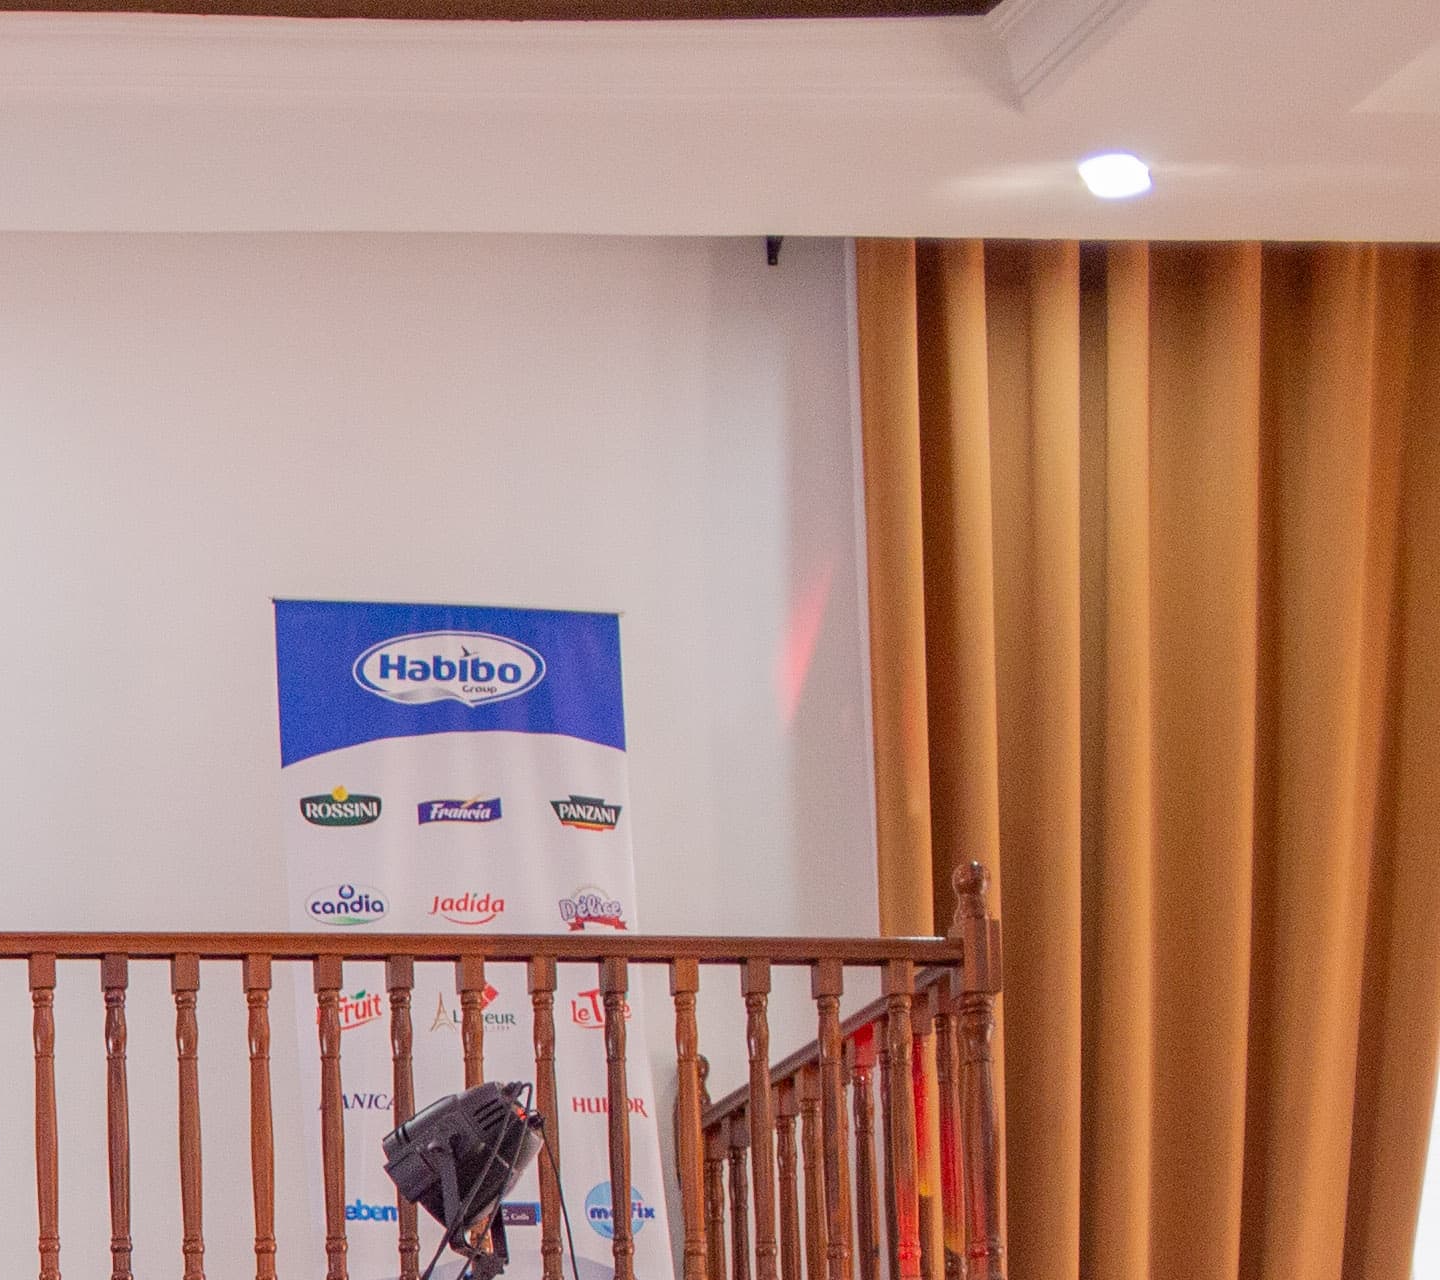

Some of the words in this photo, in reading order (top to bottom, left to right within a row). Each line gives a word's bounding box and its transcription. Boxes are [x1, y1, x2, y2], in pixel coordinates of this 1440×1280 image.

[379, 653, 522, 684] Habibo
[462, 684, 498, 695] Group
[305, 800, 379, 820] ROSSINI
[429, 800, 492, 821] Francia
[558, 801, 617, 825] PANZANI
[311, 895, 385, 914] candia
